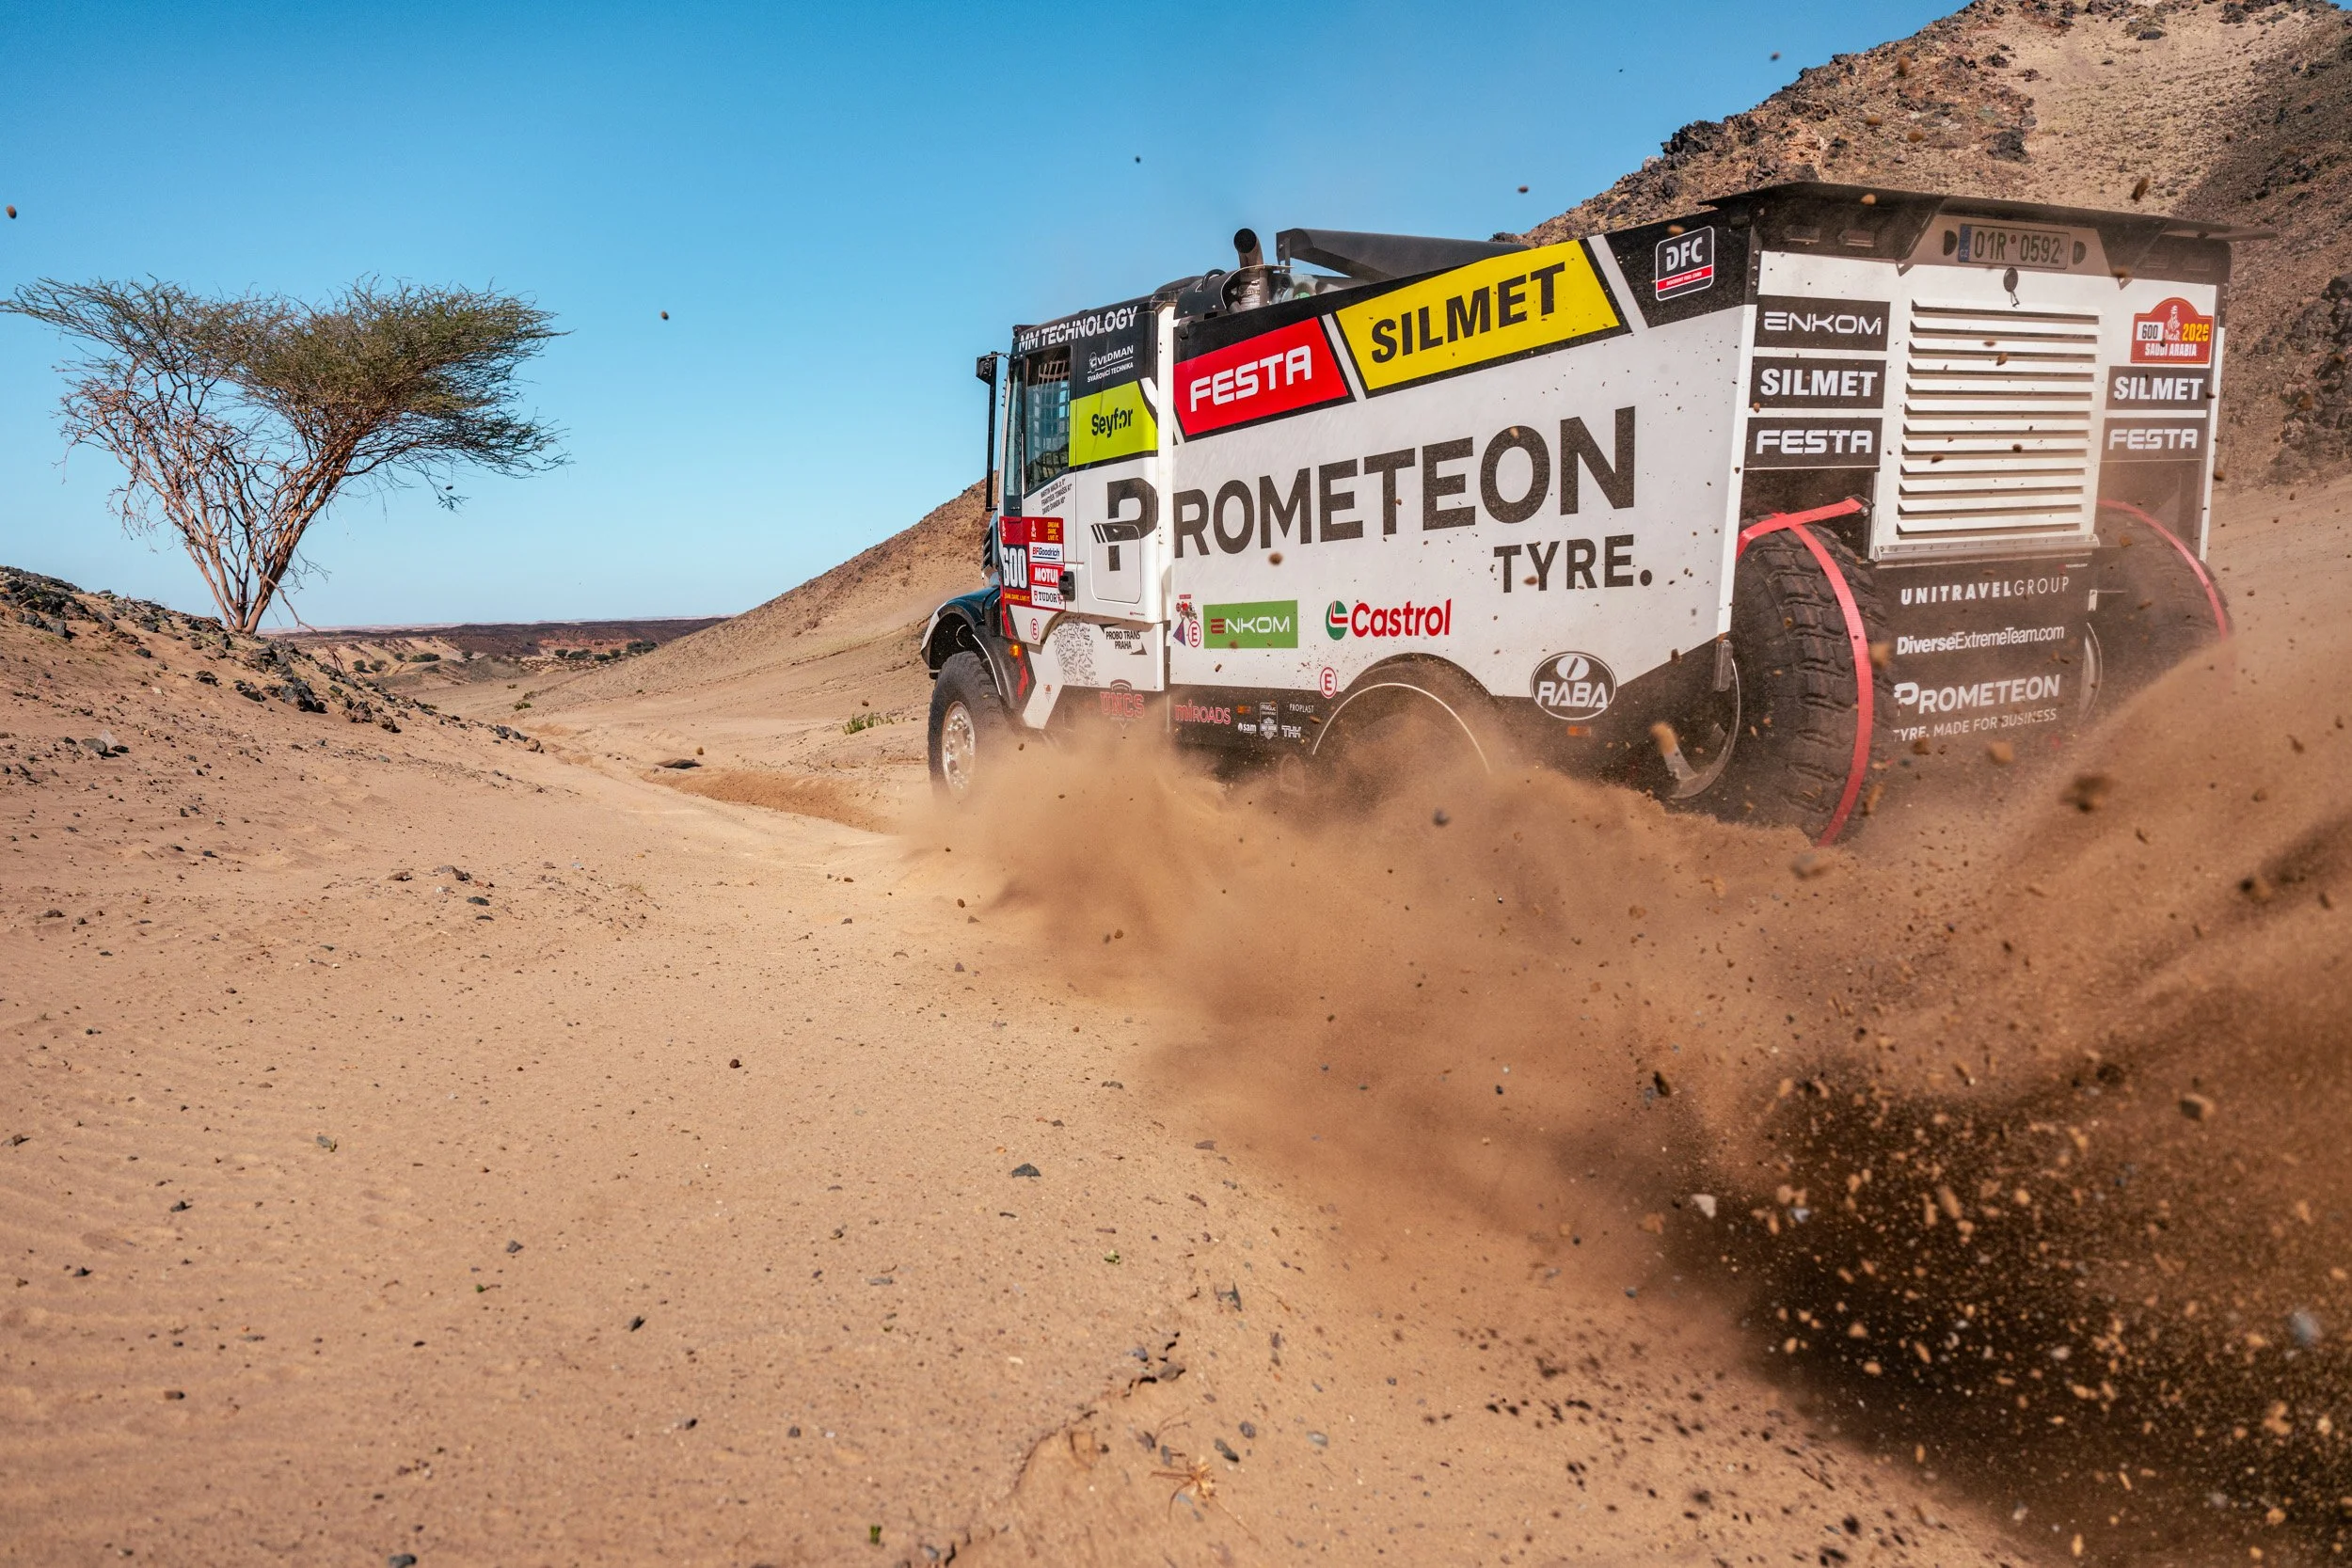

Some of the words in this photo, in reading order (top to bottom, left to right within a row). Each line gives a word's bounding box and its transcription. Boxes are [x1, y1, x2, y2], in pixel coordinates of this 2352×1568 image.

[1666, 237, 1703, 272] DFC
[1974, 230, 2007, 261] 01R
[2020, 234, 2060, 264] 0592
[1371, 261, 1565, 364] SILMET
[1764, 311, 1882, 335] ENKOM
[1019, 329, 1040, 352] MM
[1041, 306, 1138, 347] TECHNOLOGY
[2142, 325, 2158, 339] 600
[2183, 323, 2210, 341] 2025
[2145, 343, 2168, 356] SAUDI
[2169, 343, 2198, 356] ARABIA
[1190, 344, 1312, 412] FESTA
[1760, 368, 1878, 397] SILMET
[2113, 376, 2204, 400] SILMET
[1091, 407, 1133, 438] Seyfor
[1756, 430, 1873, 454] FESTA
[2108, 429, 2199, 450] FESTA
[1090, 406, 1636, 572] PROMETEON
[1032, 546, 1059, 557] BFGoodrich
[1493, 534, 1653, 593] TYRE.
[1003, 546, 1027, 589] 600
[1039, 591, 1057, 603] TUDOR
[1210, 616, 1290, 634] ENKOM
[1351, 598, 1452, 638] Castrol
[1105, 630, 1123, 640] PROBO
[1124, 630, 1140, 640] TRANS
[1191, 630, 1198, 641] E
[1897, 626, 2065, 655] DiverseExtremeTeam.com
[1324, 673, 1332, 690] E
[1894, 674, 2060, 714] PROMETEON
[1100, 692, 1145, 718] UNCS
[1243, 723, 1257, 732] sam
[1933, 720, 1969, 737] MADE
[1973, 716, 1997, 732] FOR
[2001, 707, 2058, 728] BUSINESS
